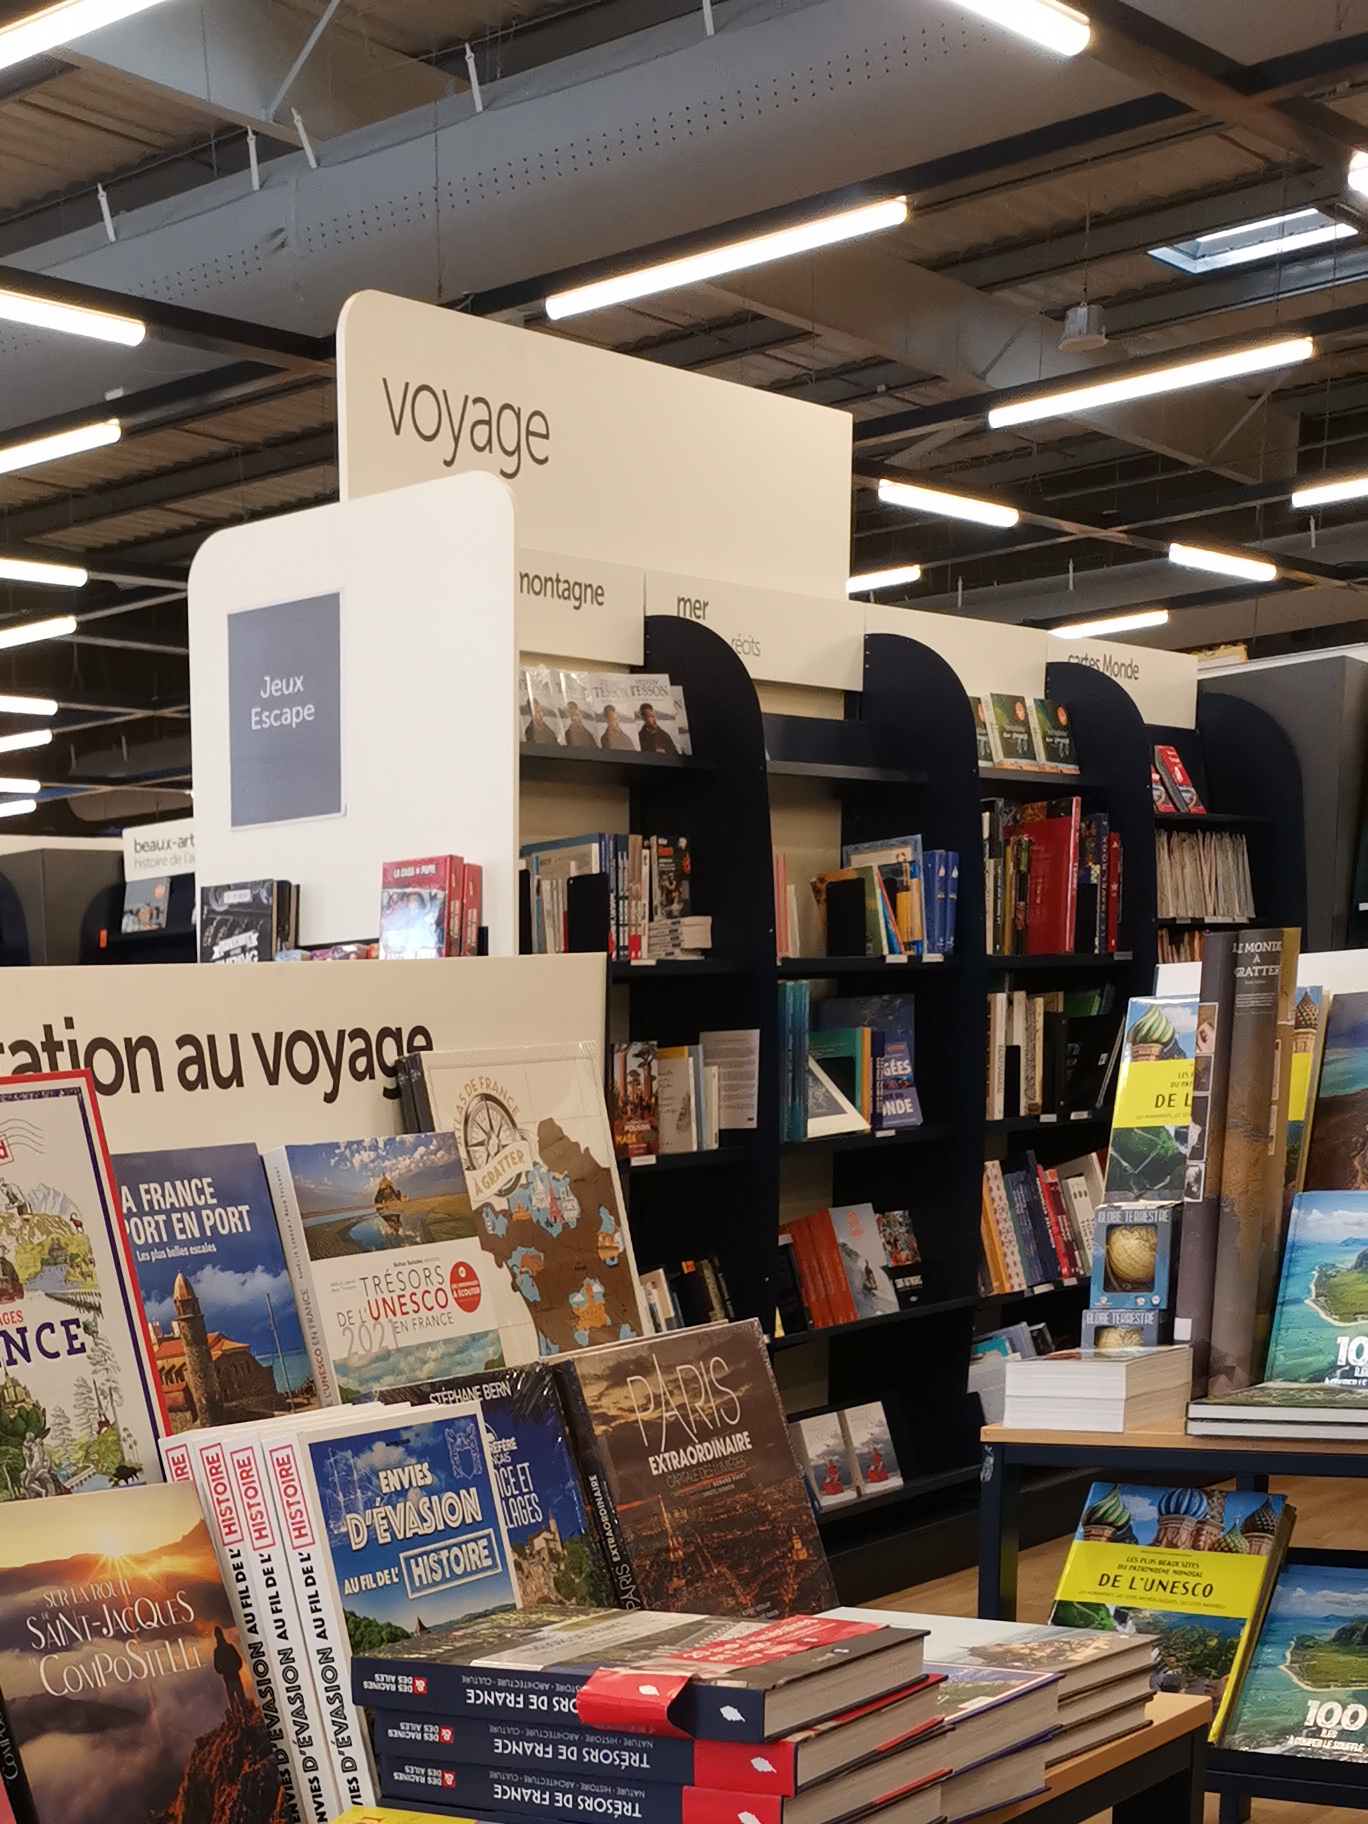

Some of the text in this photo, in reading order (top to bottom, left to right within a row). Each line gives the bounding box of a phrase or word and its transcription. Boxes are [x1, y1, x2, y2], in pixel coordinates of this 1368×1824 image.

[382, 377, 551, 479] voyage
[677, 595, 709, 620] mer
[1103, 653, 1139, 681] Monde
[259, 673, 305, 701] Jeux
[250, 702, 316, 731] Escape
[177, 1033, 244, 1092] au
[251, 1025, 434, 1104] voyage
[478, 1076, 521, 1118] FRANCE
[1154, 1093, 1178, 1109] DE
[482, 1149, 525, 1190] GRATTER
[139, 1177, 218, 1212] FRANCE
[171, 1205, 252, 1240] EN PORT
[359, 1265, 446, 1298] TRÉSORS
[411, 1311, 454, 1331] FRANCE
[429, 1379, 511, 1406] STÉPHANE BERN
[626, 1352, 742, 1453] PARIS
[648, 1432, 753, 1478] EXTRAORDINAIRE
[206, 1452, 239, 1538] HISTOIRE
[378, 1461, 434, 1494] ENVIES
[236, 1456, 269, 1542] HISTOIRE
[275, 1454, 324, 1614] FIL HISTOIRE
[346, 1486, 483, 1552] D'ÉVASION
[588, 1474, 621, 1563] EXTRAORDINAIRE
[409, 1536, 494, 1588] HISTOIRE
[1098, 1573, 1214, 1598] DE L'UNESCO
[26, 1590, 194, 1651] SAINT-JACQUES
[39, 1637, 209, 1696] COMPOSTELLE
[465, 1687, 524, 1709] FRANCE
[1304, 1699, 1368, 1731] 100
[492, 1737, 651, 1770] TRÉSORS FRANCE
[492, 1783, 642, 1819] TRÉSORS FRANCE
